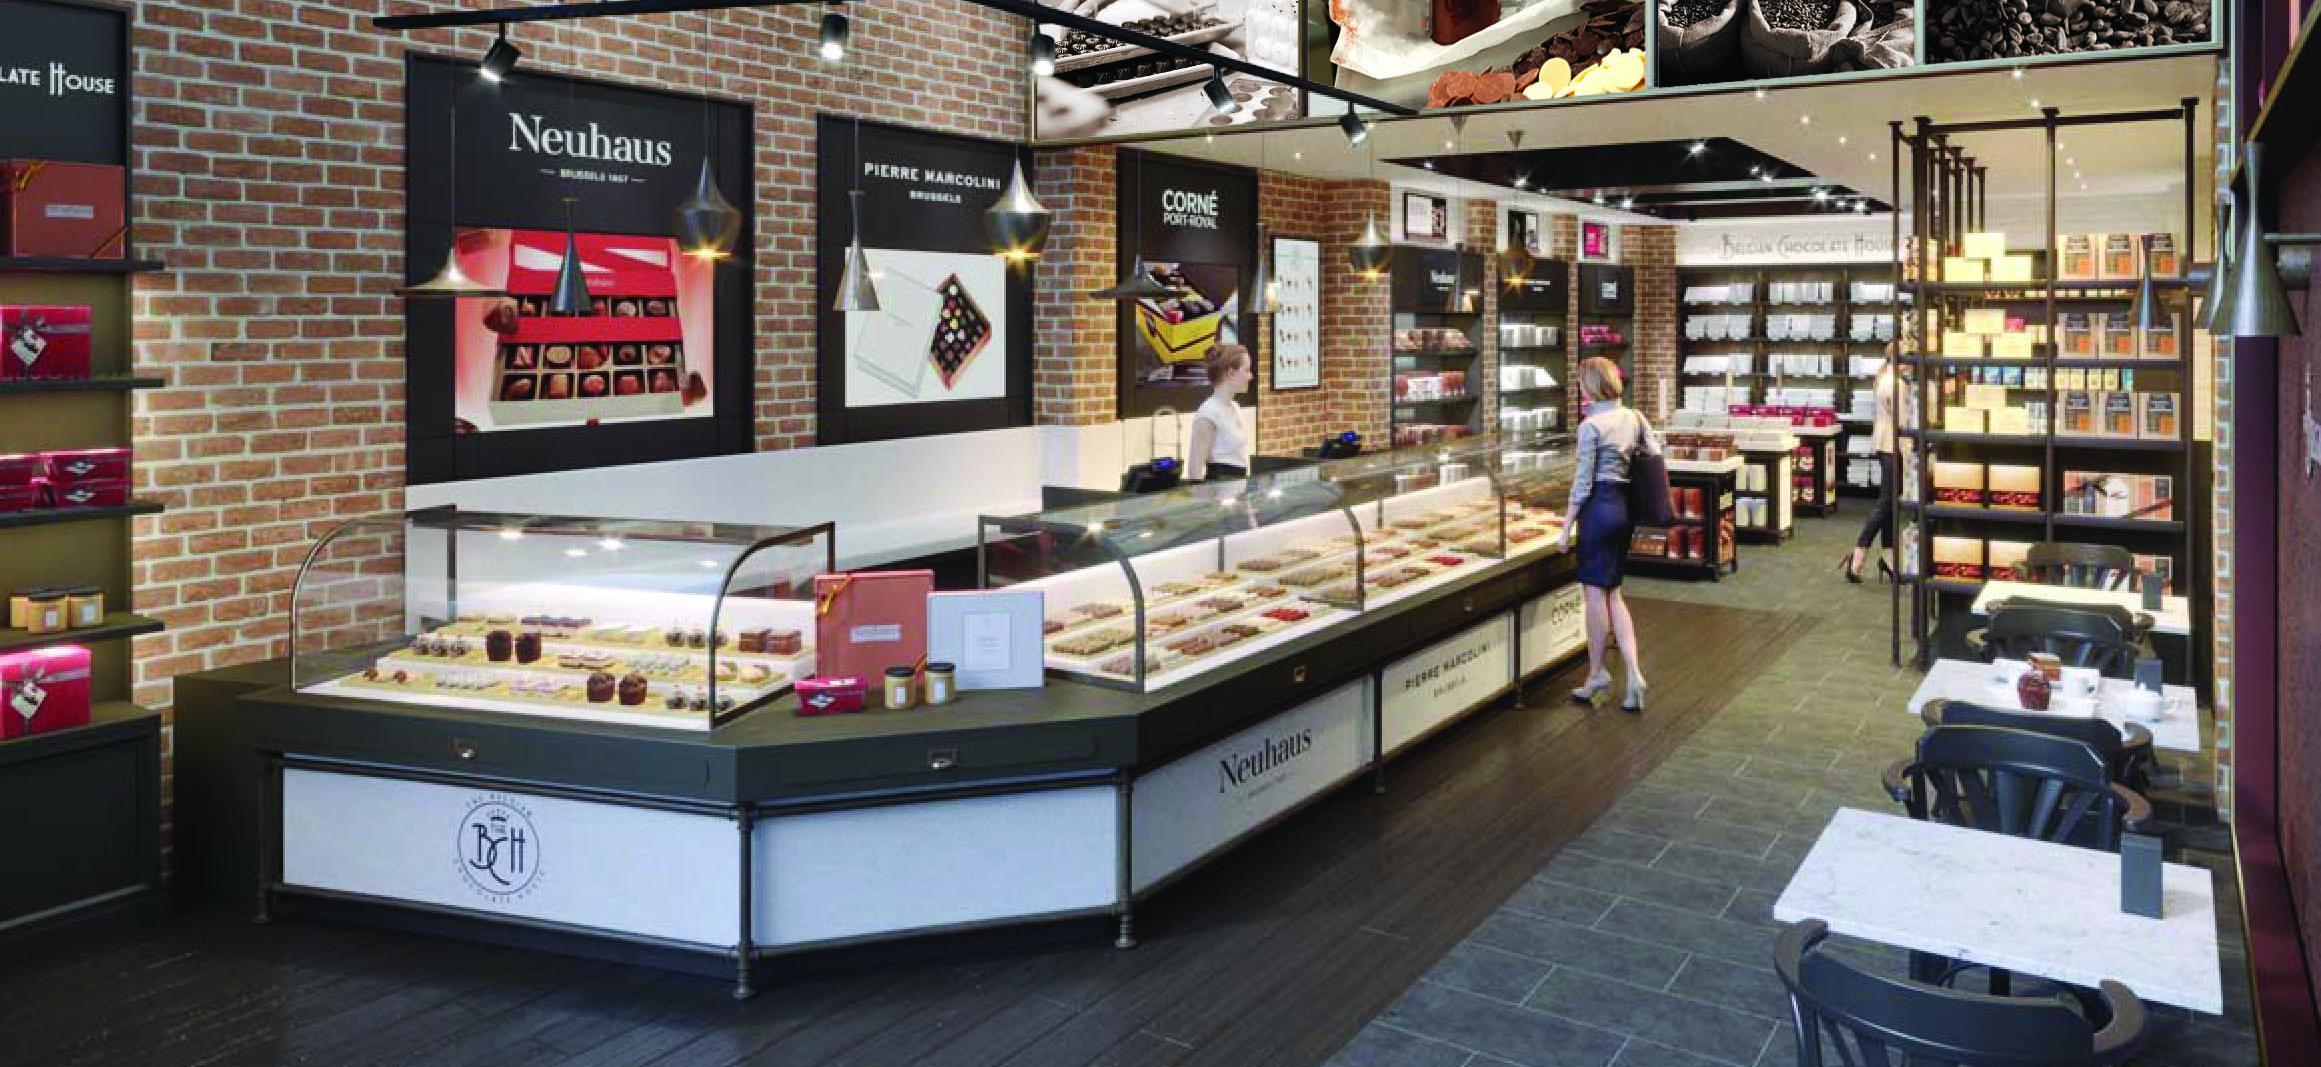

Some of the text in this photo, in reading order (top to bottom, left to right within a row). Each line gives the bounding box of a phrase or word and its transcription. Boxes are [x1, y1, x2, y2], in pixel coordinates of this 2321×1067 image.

[508, 112, 672, 166] Neuhaus
[864, 162, 1001, 190] PIERRE MARCOLINI
[1162, 189, 1218, 216] CORNÉ
[1218, 728, 1312, 794] Neuhaus
